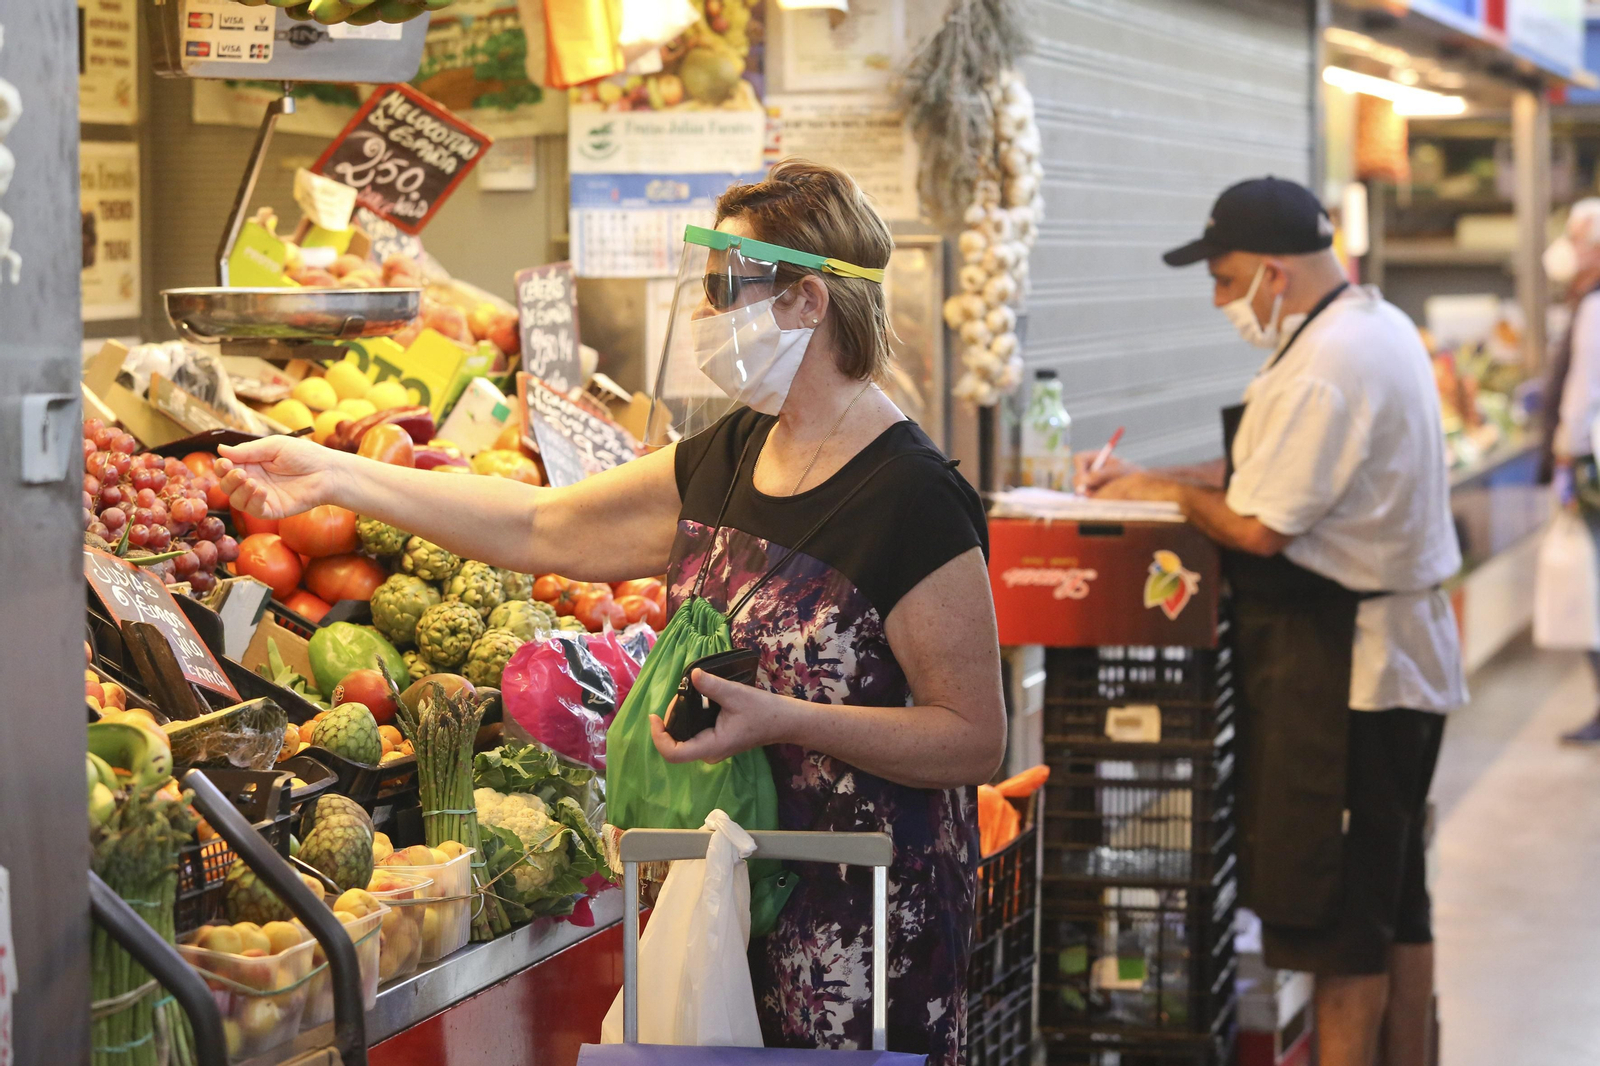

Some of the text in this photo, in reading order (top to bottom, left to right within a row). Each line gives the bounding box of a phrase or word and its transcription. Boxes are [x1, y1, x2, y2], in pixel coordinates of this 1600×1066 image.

[223, 17, 244, 25] VISA
[221, 44, 241, 52] VISA
[181, 655, 231, 692] EXTRA
